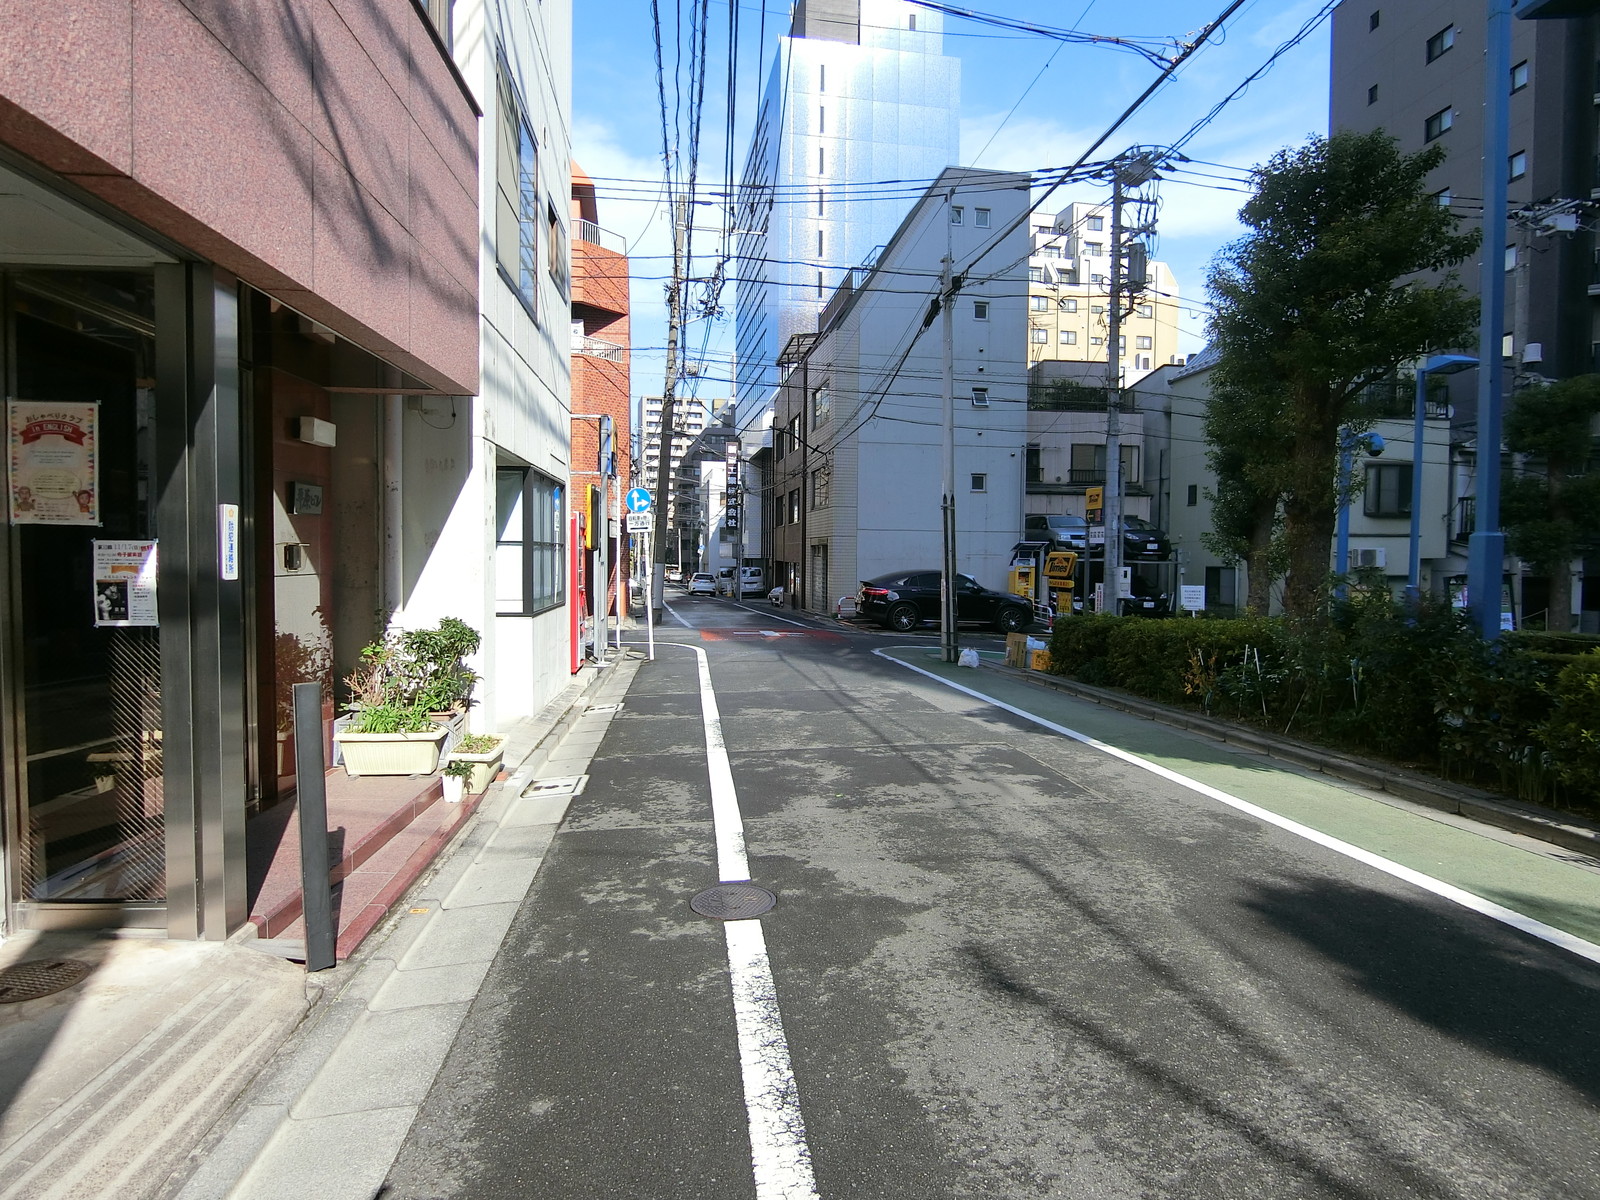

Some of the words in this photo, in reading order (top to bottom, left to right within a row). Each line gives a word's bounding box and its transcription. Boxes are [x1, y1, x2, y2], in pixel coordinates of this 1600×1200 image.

[26, 412, 83, 423] おしゃべりクラブ
[43, 423, 73, 433] ENGLISH
[1049, 559, 1068, 573] Times
